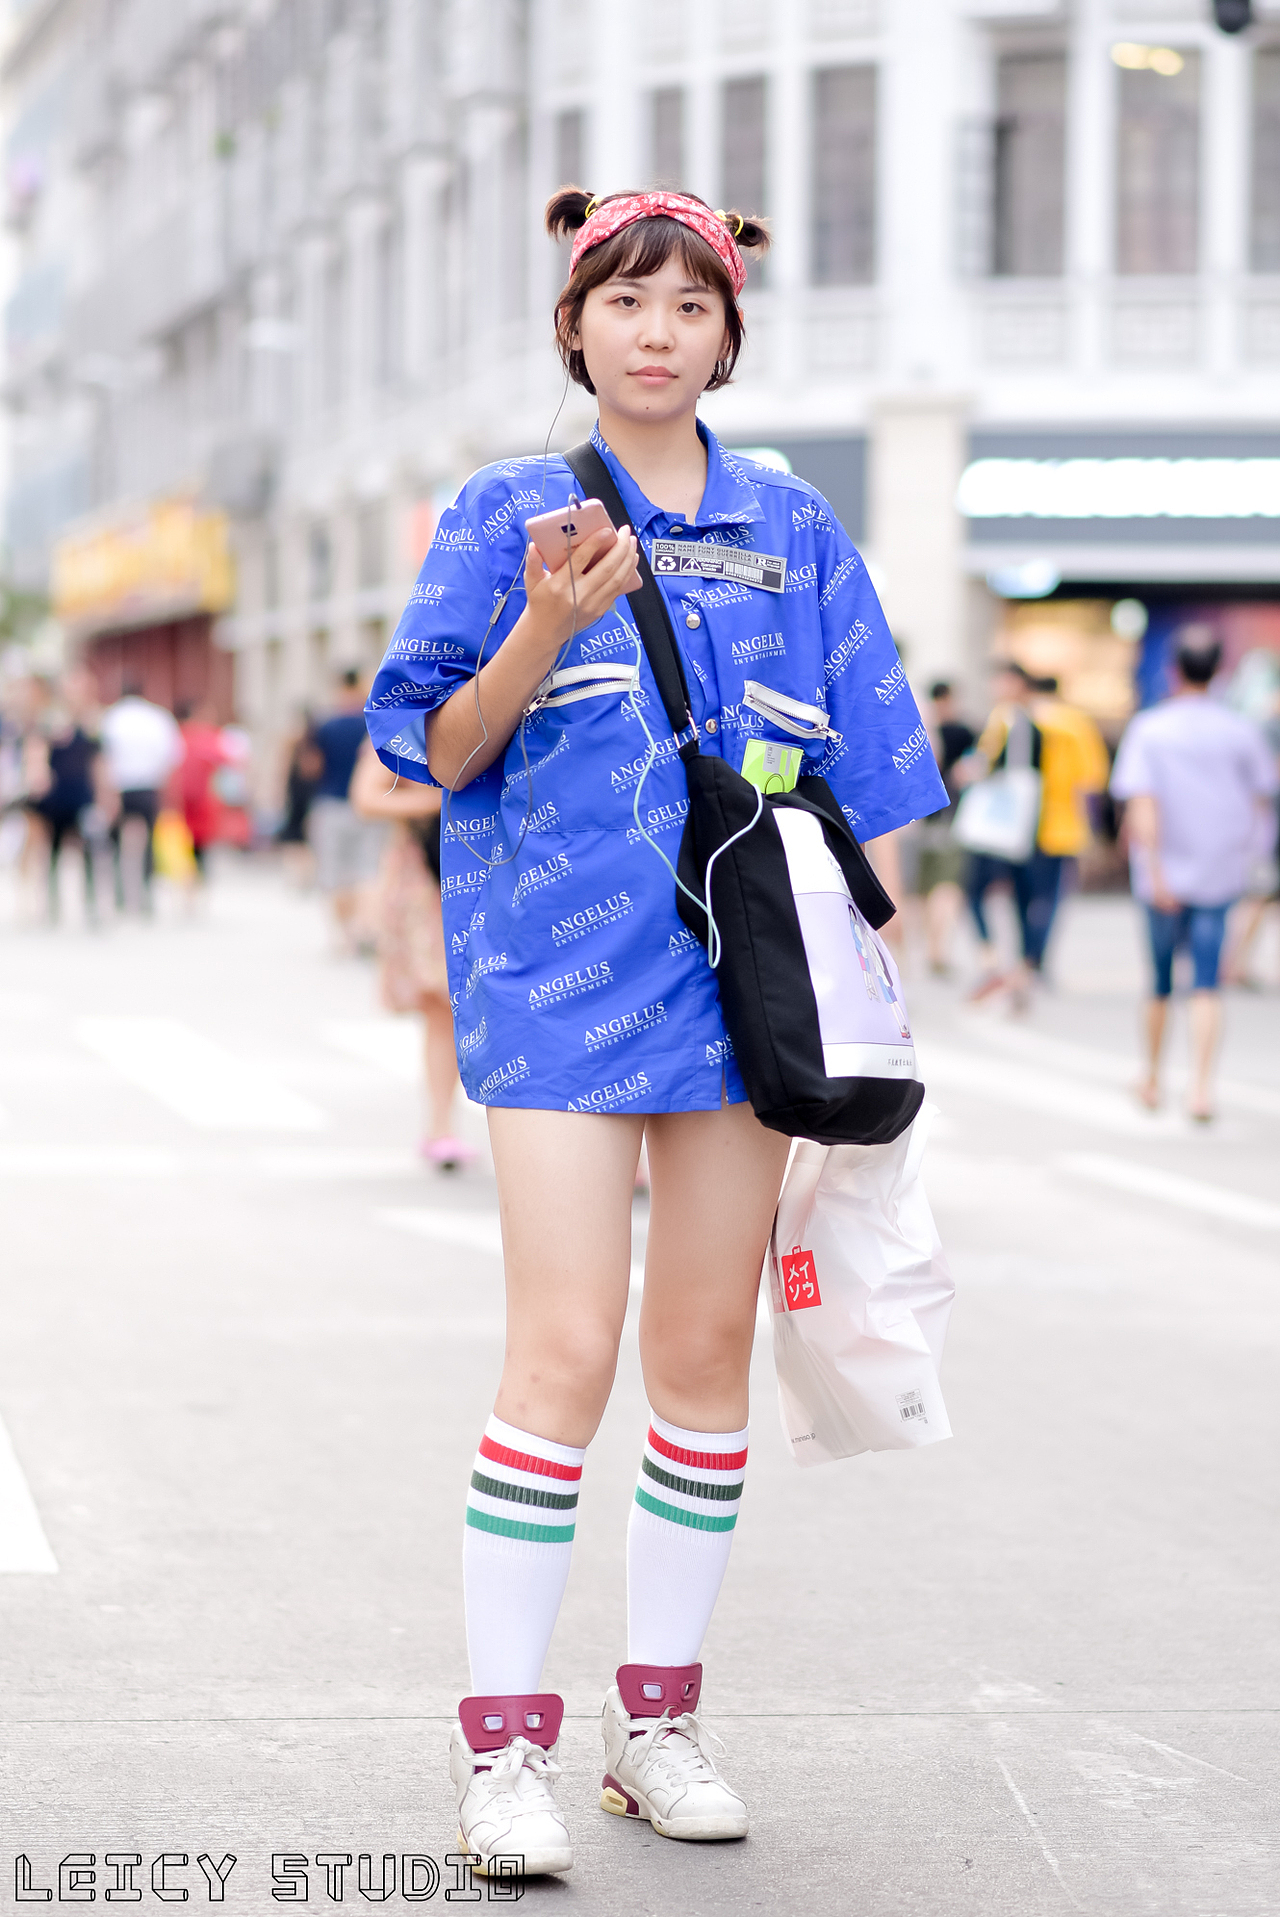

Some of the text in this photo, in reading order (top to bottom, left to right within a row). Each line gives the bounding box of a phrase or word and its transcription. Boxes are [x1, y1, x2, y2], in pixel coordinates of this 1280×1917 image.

[482, 490, 541, 537] ANGELUS
[388, 654, 464, 662] ENTERTAINMENT
[391, 638, 465, 654] ANGELUS
[584, 639, 642, 664] ENTERTAIN
[731, 632, 784, 655] ANGELUS
[824, 619, 865, 679] NGELUS
[551, 891, 631, 939] ANGELUS
[555, 906, 634, 948] ENTERTAINMENT
[528, 961, 611, 1001] ANGELUS
[530, 976, 614, 1011] ENTERTAINMENT
[584, 1001, 665, 1043] ANGELUS
[587, 1015, 668, 1053] ENTERTAINMENT
[479, 1055, 527, 1100] ANGELUS
[567, 1071, 649, 1112] ANGELUS
[787, 1260, 810, 1284] メイ
[788, 1280, 815, 1302] ソウ
